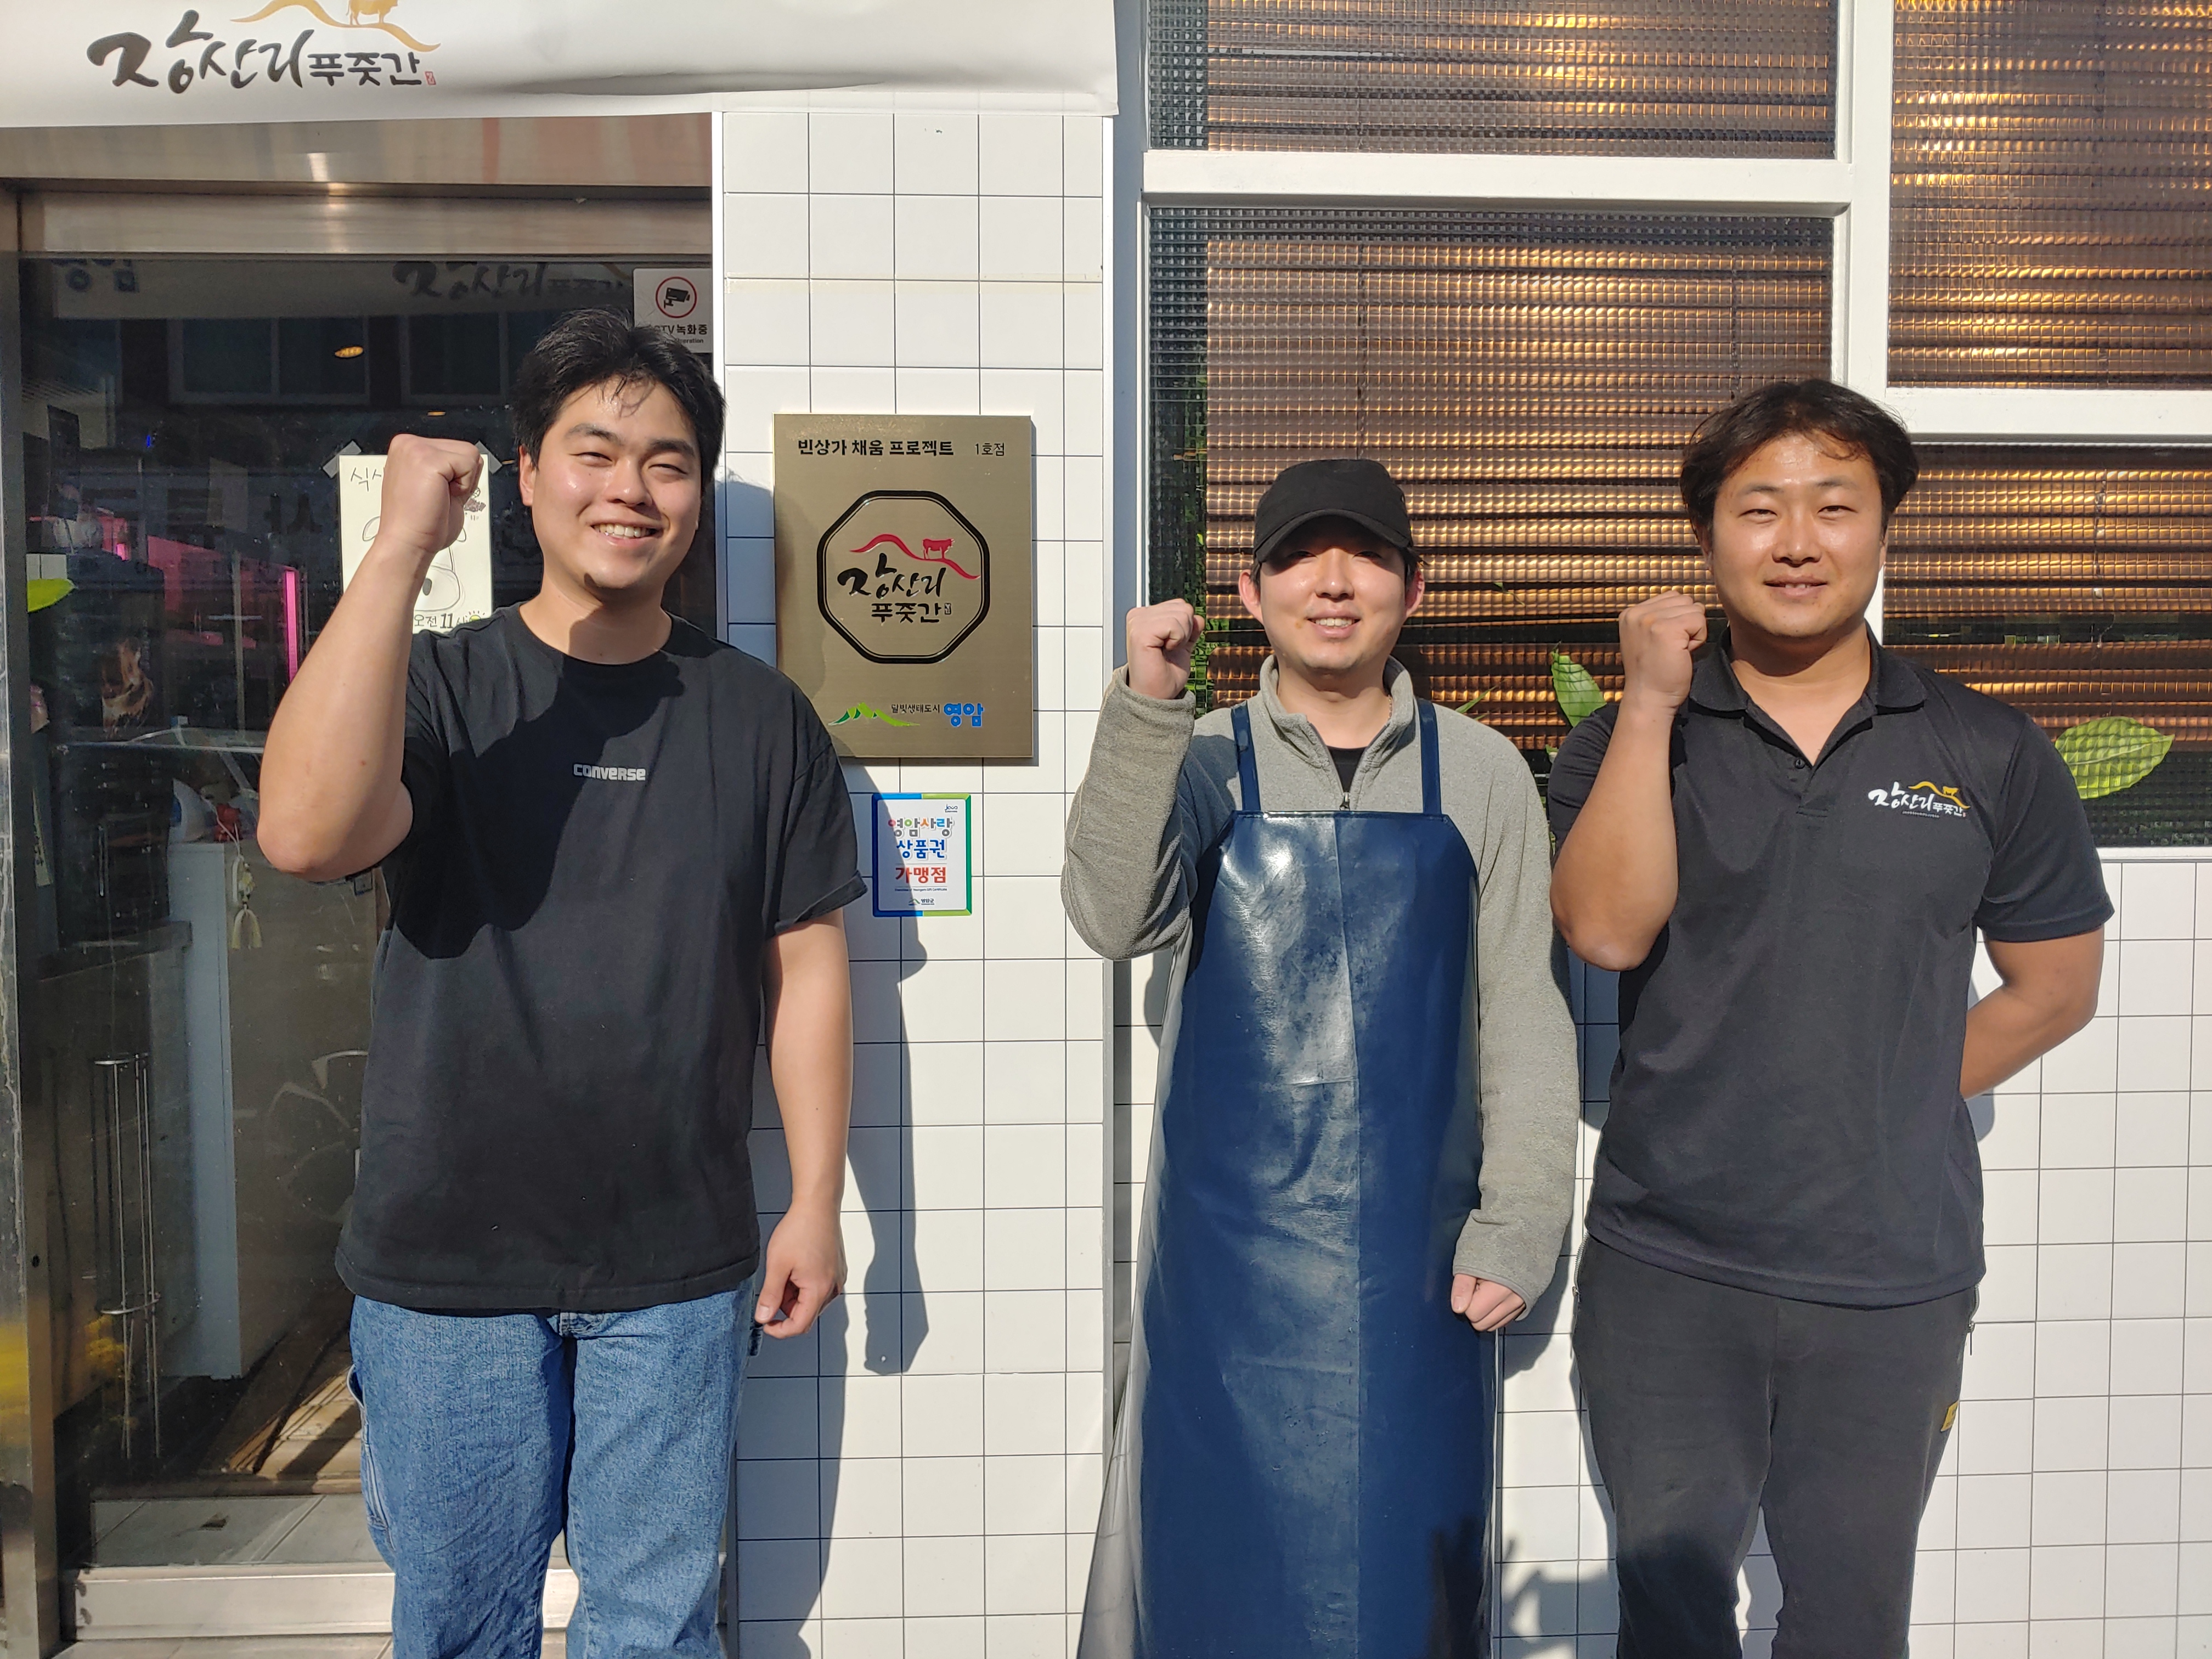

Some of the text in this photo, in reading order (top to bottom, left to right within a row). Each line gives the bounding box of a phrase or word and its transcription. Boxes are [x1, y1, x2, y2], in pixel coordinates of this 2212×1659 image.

[87, 10, 422, 94] 장산리 푸줏간
[676, 324, 708, 335] 녹화중
[798, 439, 1005, 456] 빈상가 채움 프로젝트 1호점
[837, 552, 946, 600] 장산리
[414, 614, 438, 628] 오전
[871, 603, 941, 624] 푸줏간
[944, 703, 985, 727] 영암
[1933, 802, 1963, 817] 푸줏간
[888, 817, 953, 837] 영암사랑
[896, 839, 946, 859] 상품권
[895, 866, 946, 884] 가맹점
